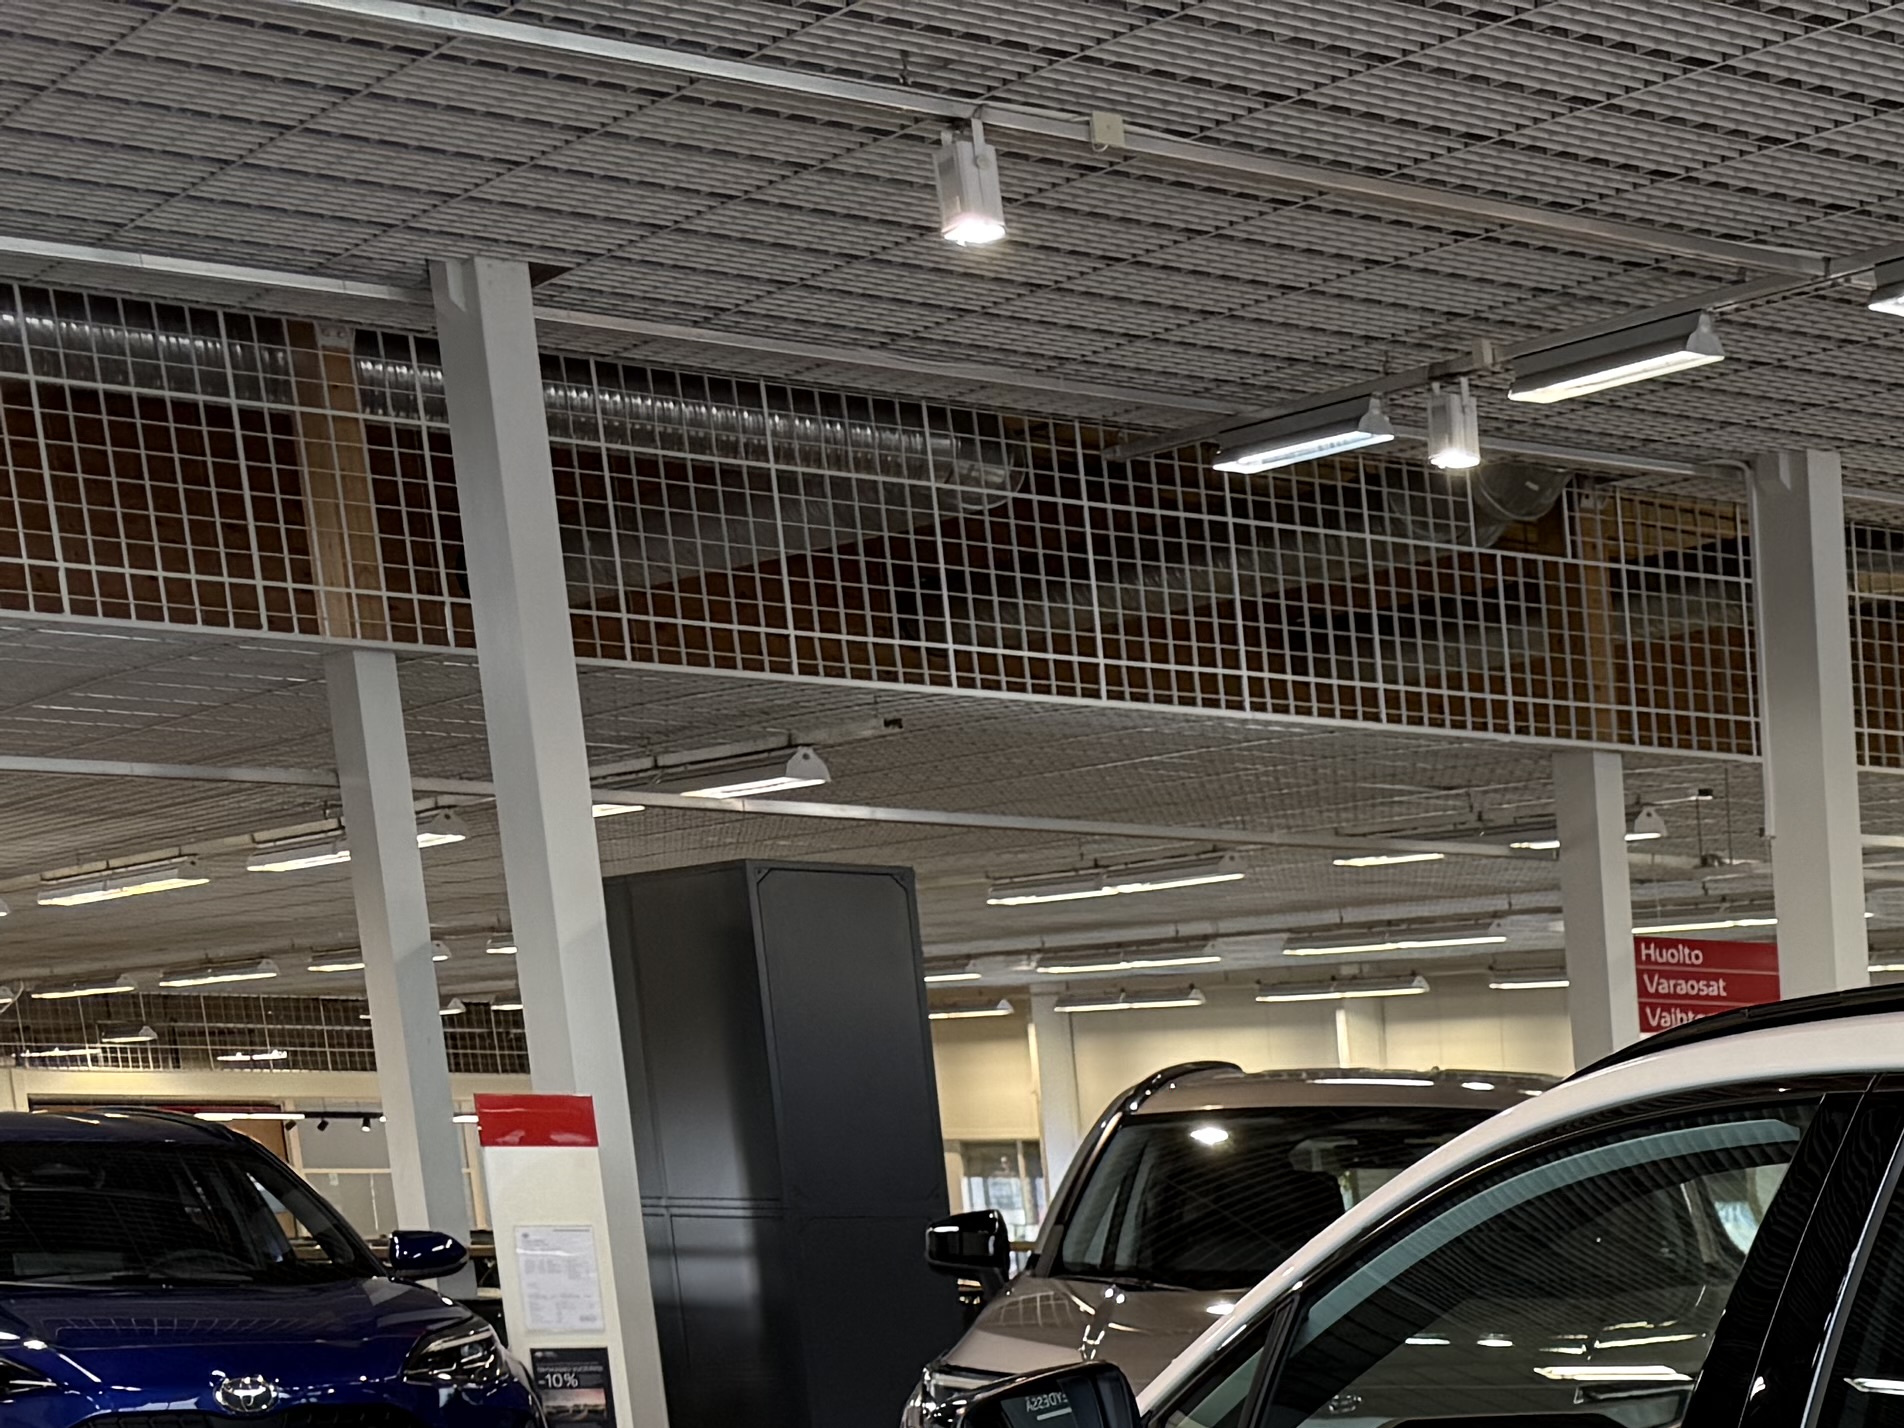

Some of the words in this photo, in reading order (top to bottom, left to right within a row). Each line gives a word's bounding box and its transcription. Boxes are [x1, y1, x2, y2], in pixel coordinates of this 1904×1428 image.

[1641, 942, 1703, 965] Huolto
[1643, 973, 1728, 997] Varaosat
[538, 1373, 579, 1388] -10%
